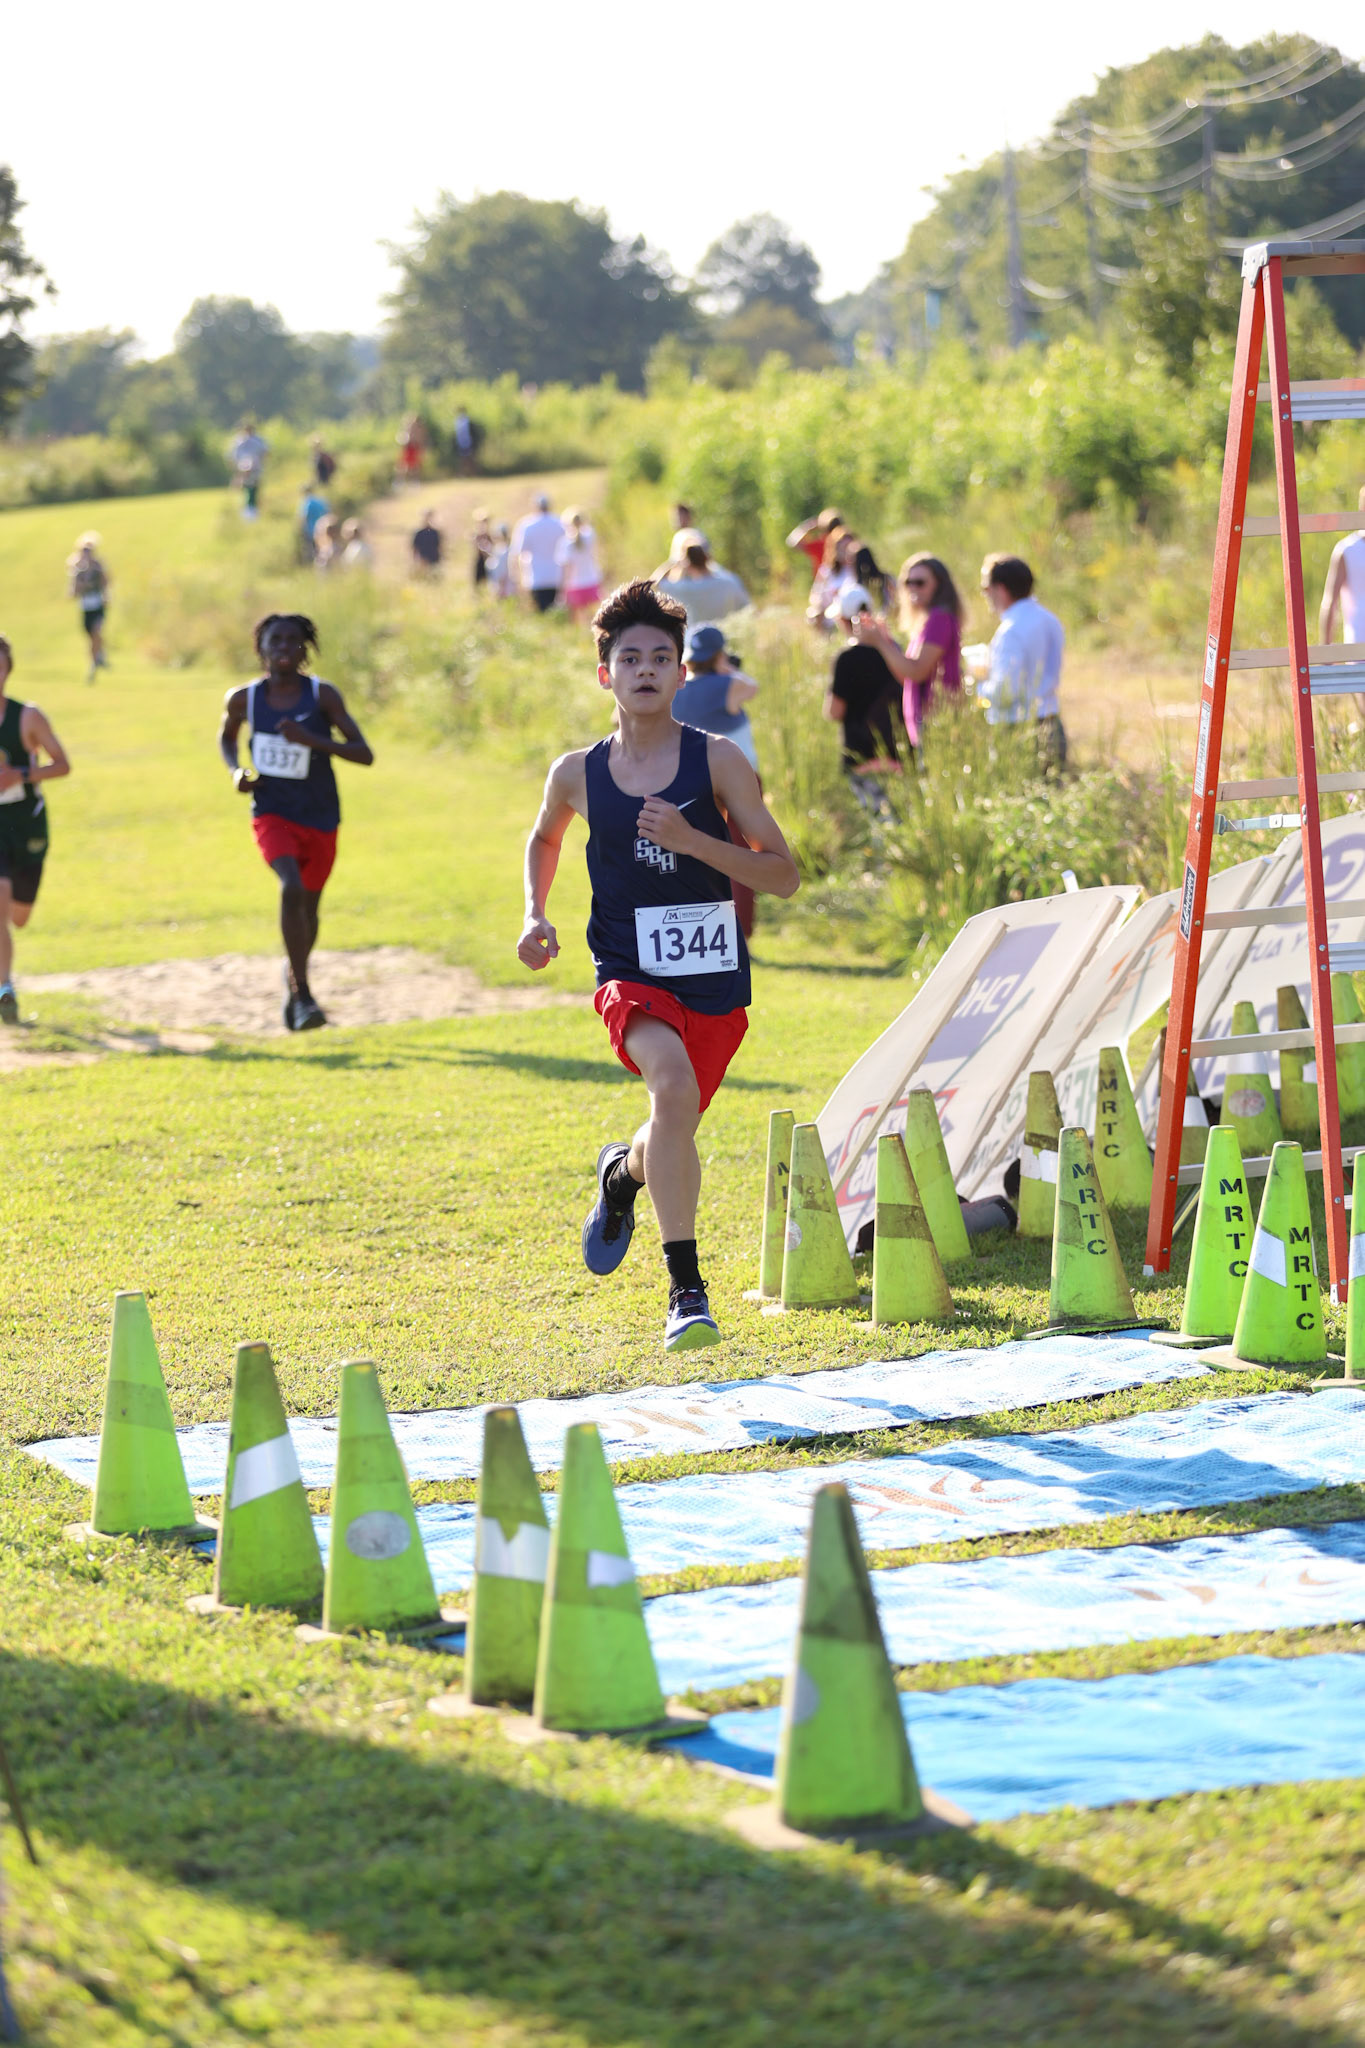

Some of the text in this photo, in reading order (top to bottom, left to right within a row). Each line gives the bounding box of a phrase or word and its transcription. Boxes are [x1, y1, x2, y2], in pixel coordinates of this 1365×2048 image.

[635, 838, 676, 872] SBA
[649, 923, 728, 963] 1344
[1072, 1163, 1107, 1255] MRTC
[1219, 1178, 1249, 1278] MRTC
[1289, 1226, 1315, 1331] MRTC
